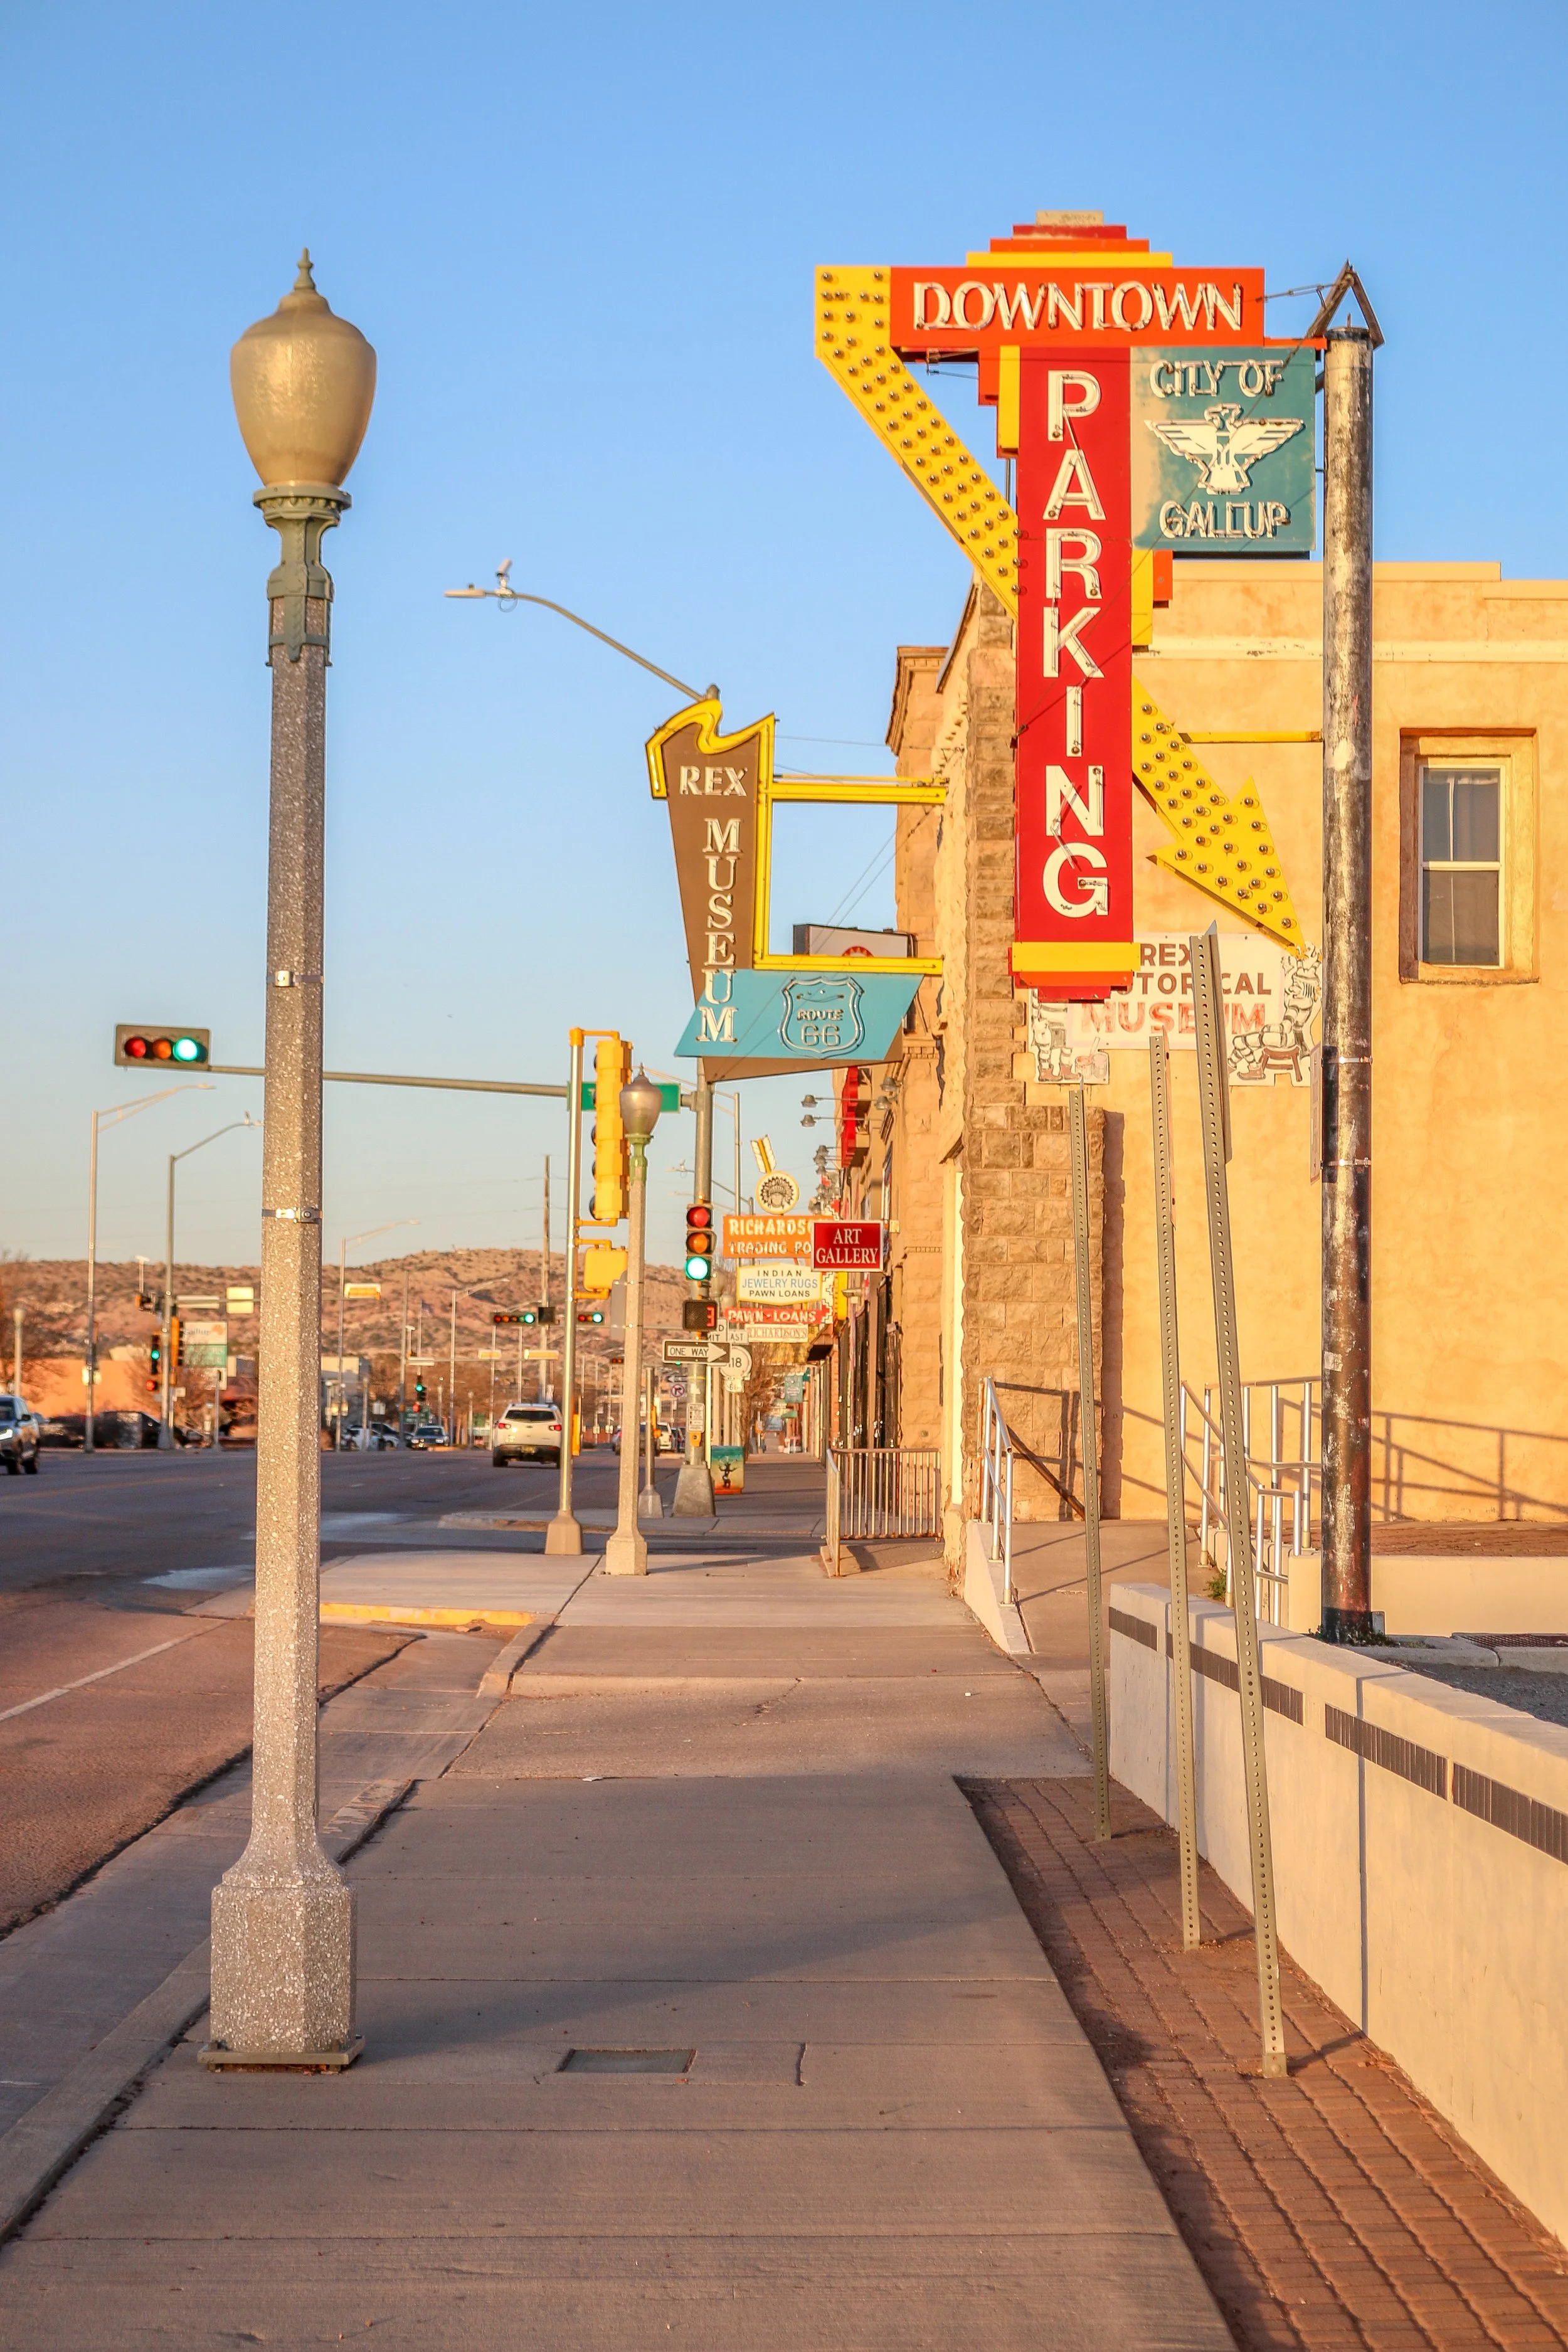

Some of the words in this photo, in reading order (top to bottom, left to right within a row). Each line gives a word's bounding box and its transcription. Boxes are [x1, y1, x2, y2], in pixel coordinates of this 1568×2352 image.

[913, 281, 1243, 331] DOWNTOWN
[1150, 359, 1225, 398] CITY
[1238, 359, 1285, 398] OF
[1160, 501, 1290, 539] GALLUP
[1042, 369, 1109, 918] PARKING
[679, 765, 748, 797] REX
[696, 817, 741, 1044] MUSEUM
[797, 1008, 844, 1022] ROUTE
[1081, 1002, 1266, 1035] MUSEM
[801, 1024, 840, 1047] 66
[728, 1241, 788, 1254] TRADING
[794, 1241, 812, 1254] PO
[833, 1228, 862, 1244] ART
[816, 1248, 879, 1264] GALLERY
[743, 1278, 788, 1288] JEWELRY
[791, 1278, 818, 1289] RUGS
[730, 1333, 744, 1342] AST
[669, 1347, 686, 1356] ONE
[691, 1348, 709, 1357] WAY
